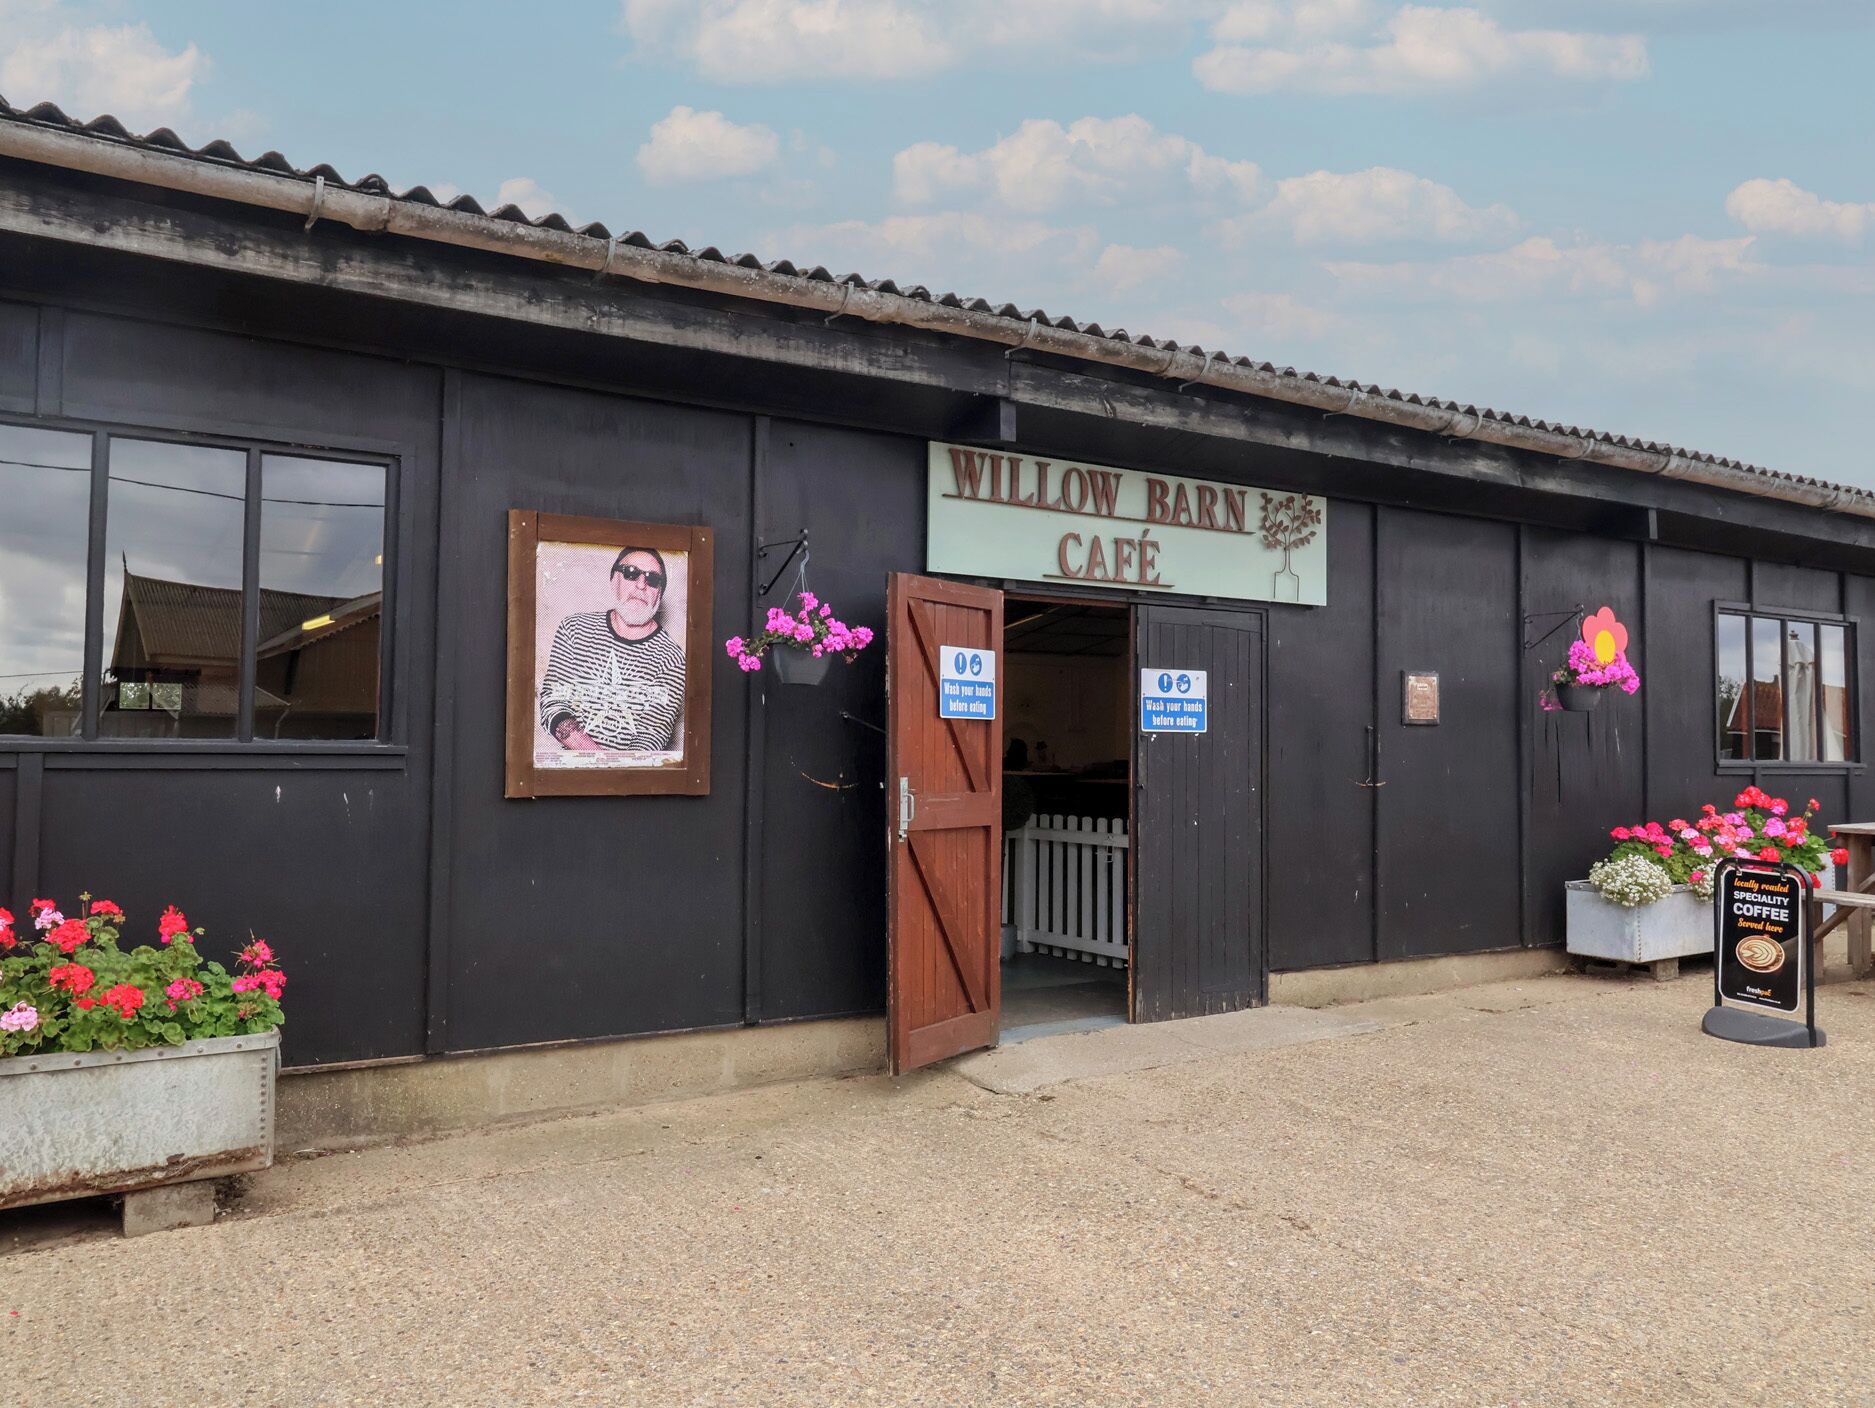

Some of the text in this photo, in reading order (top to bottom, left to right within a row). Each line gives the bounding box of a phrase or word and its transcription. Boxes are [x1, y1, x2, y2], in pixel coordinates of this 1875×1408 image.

[948, 448, 1248, 532] WILLOW BARN
[1058, 528, 1161, 586] CAFÉ
[944, 682, 992, 697] Wash your hands
[949, 699, 987, 715] before eating
[1145, 699, 1203, 713] Wash your hands
[1152, 714, 1197, 728] before eating
[1734, 877, 1789, 893] locally roasted
[1733, 891, 1790, 906] SPECIALITY
[1733, 902, 1789, 922] COFFEE
[1737, 917, 1784, 933] Served here
